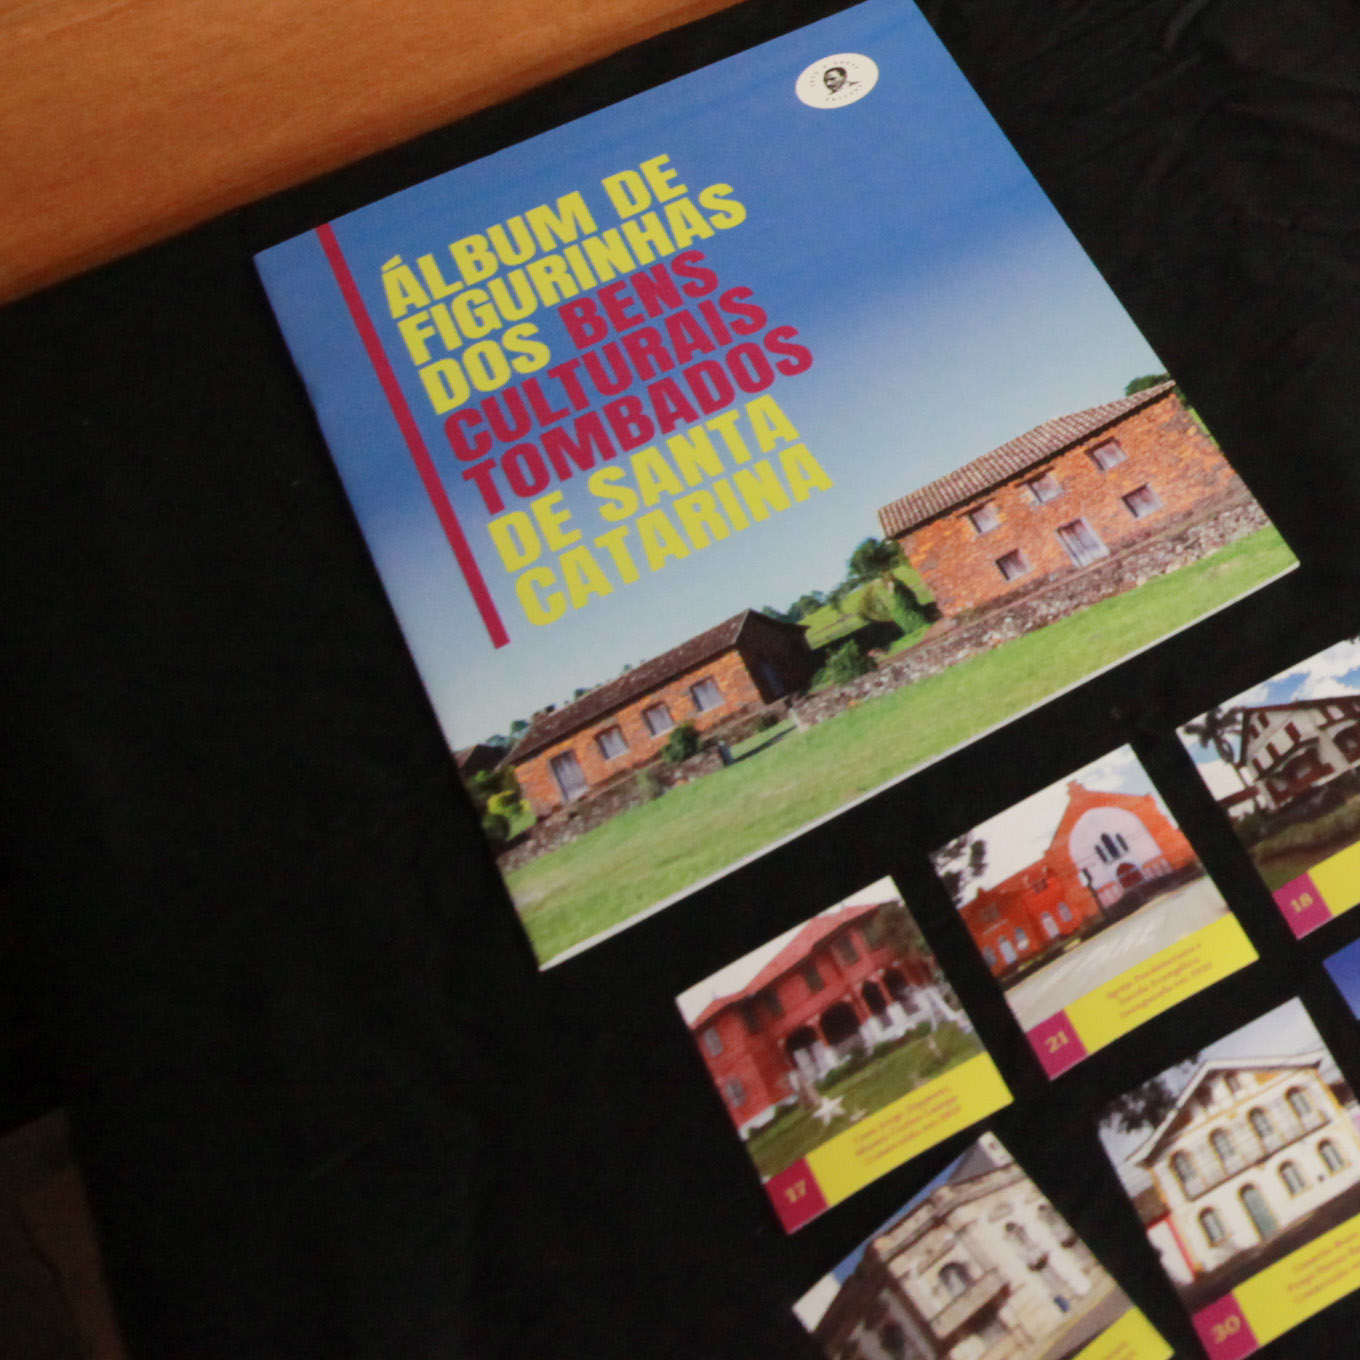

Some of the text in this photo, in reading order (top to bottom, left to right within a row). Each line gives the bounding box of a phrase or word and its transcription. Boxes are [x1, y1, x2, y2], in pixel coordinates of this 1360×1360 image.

[381, 153, 689, 320] ÁLBUM DE
[396, 182, 748, 367] FIGURINHAS
[417, 250, 720, 416] DOS BENS
[443, 285, 770, 463] CULTURAIS
[461, 324, 814, 516] TOMBADOS
[486, 393, 801, 574] DE SANTA
[514, 441, 835, 627] CATARINA
[1290, 892, 1314, 913] 18
[1045, 1030, 1069, 1053] 21
[1210, 1315, 1241, 1344] 30
